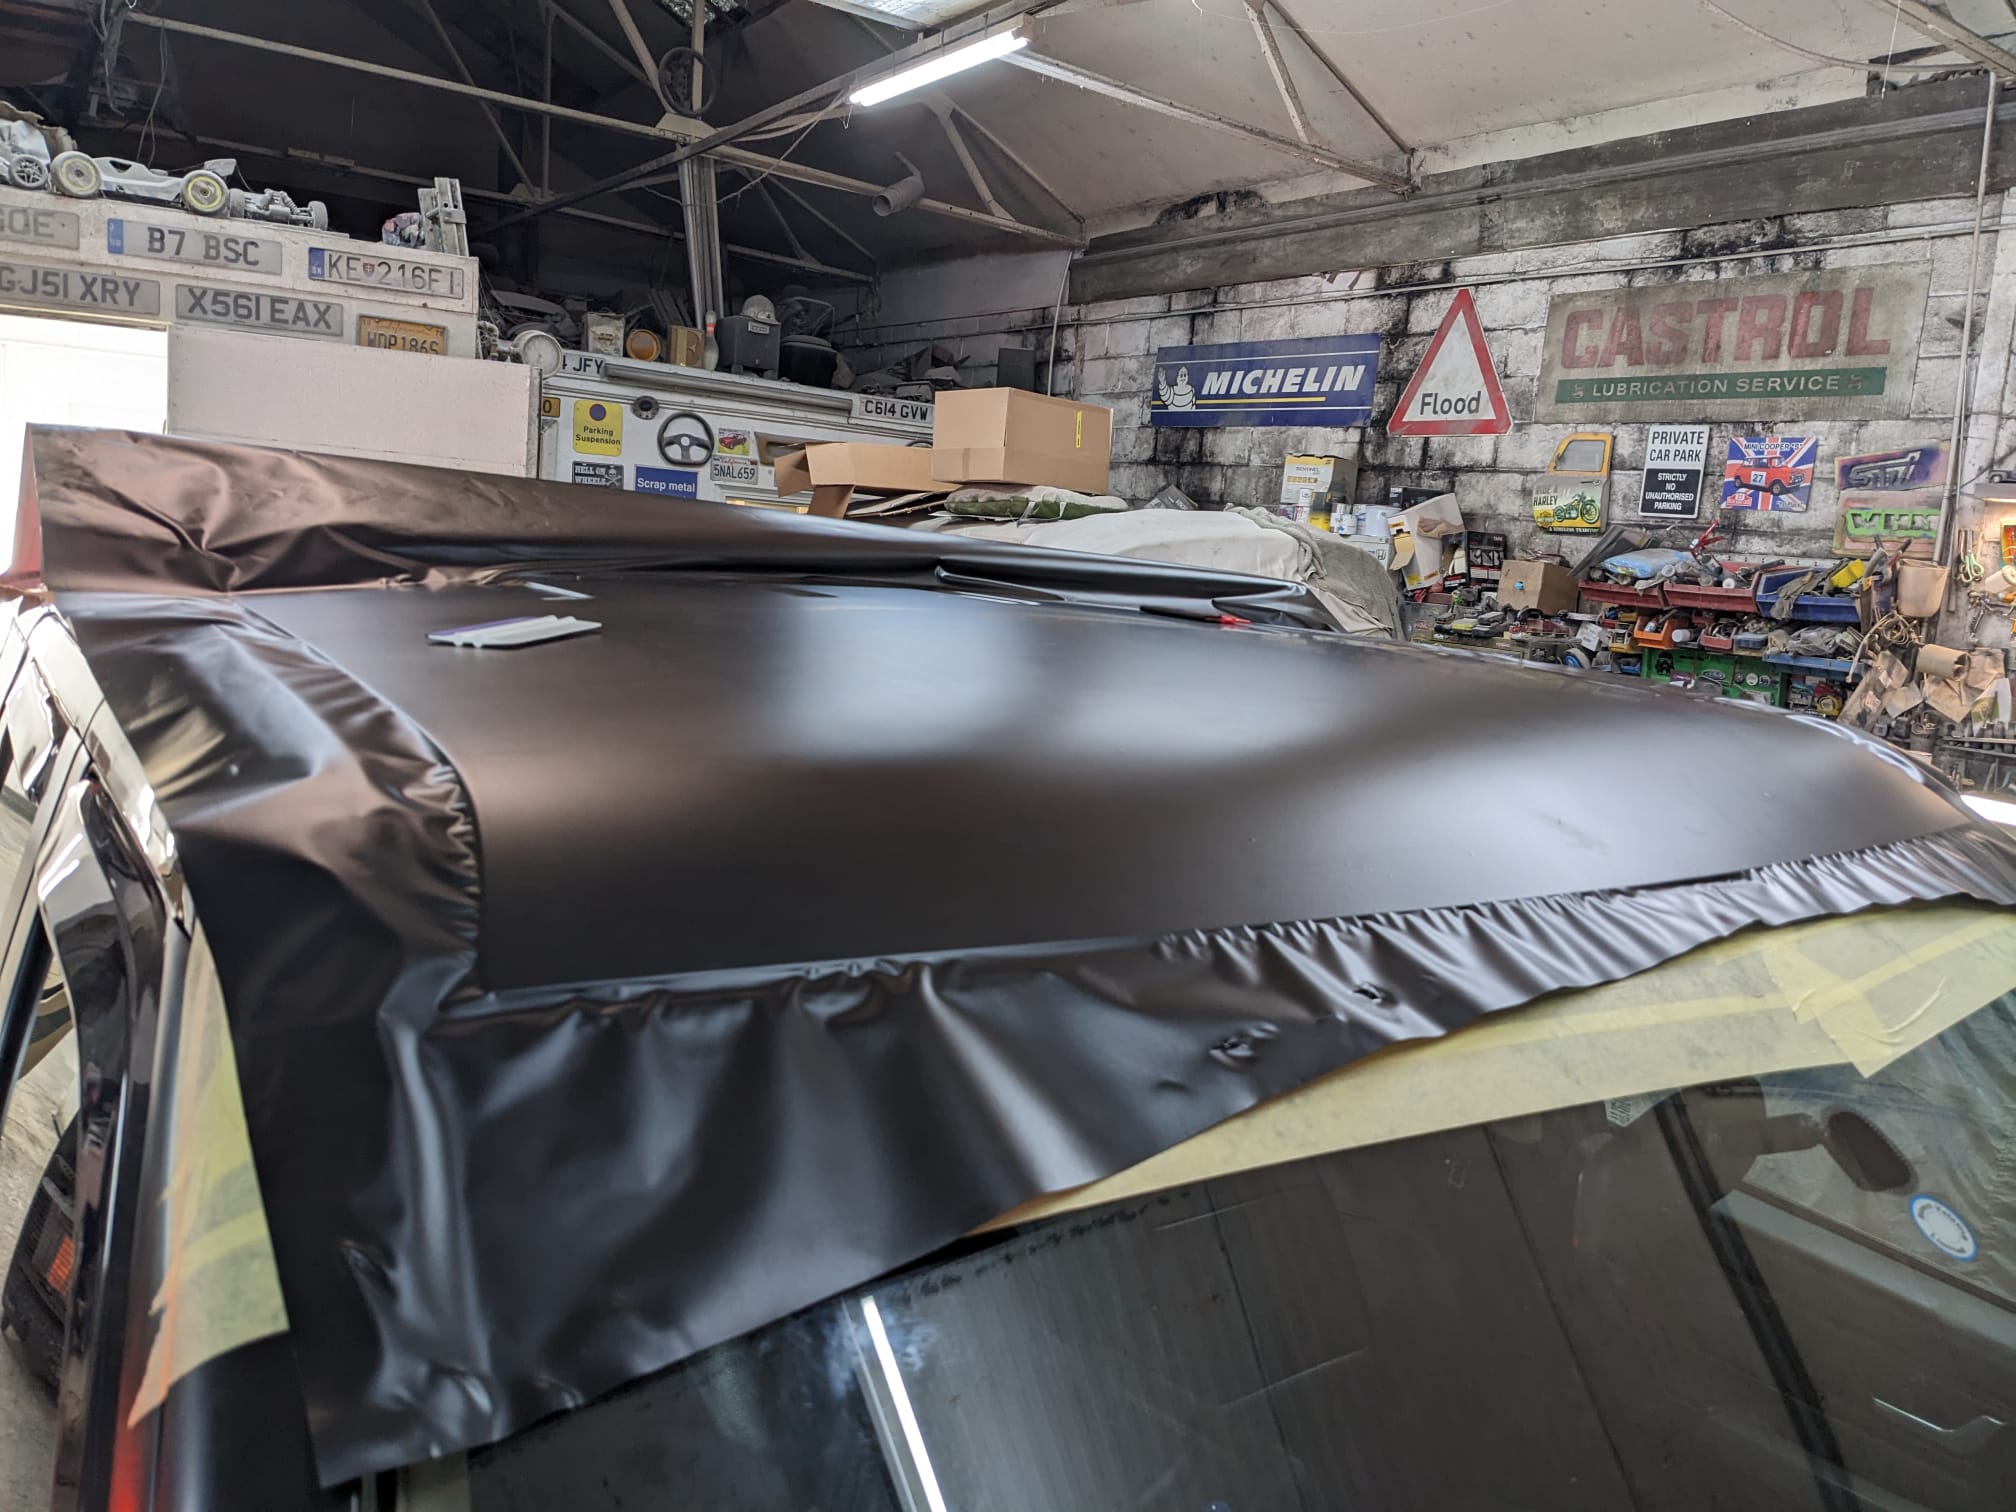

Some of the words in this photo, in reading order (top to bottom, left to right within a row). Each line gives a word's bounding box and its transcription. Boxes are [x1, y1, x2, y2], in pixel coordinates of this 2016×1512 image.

[147, 226, 185, 256] B7
[203, 234, 260, 267] BSC
[328, 253, 361, 282] KE
[79, 274, 141, 307] XRY
[187, 287, 261, 321] X561
[269, 297, 332, 331] EAX
[1560, 287, 1891, 369] CASTROL
[572, 357, 604, 374] JFY
[1200, 364, 1366, 395] MICHELIN
[1592, 378, 1728, 397] LUBRICATION
[1735, 375, 1841, 392] SERVICE
[864, 399, 897, 417] C614
[900, 404, 928, 421] GVW
[1420, 390, 1482, 416] Flood
[583, 425, 614, 436] Parking
[1651, 431, 1704, 445] PRIVATE
[575, 434, 621, 446] Suspension
[1759, 442, 1790, 451] COOPER
[1649, 449, 1671, 462] CAR
[1672, 449, 1702, 463] PARK
[713, 463, 756, 480] 5NAL659
[1657, 472, 1687, 481] STRICTLY
[1752, 473, 1764, 483] 27
[637, 477, 666, 492] Scrap
[668, 481, 695, 493] metal
[1665, 482, 1676, 491] NO
[1533, 495, 1558, 506] HARLEY
[1645, 491, 1694, 501] UNAUTHORISED
[1654, 501, 1682, 511] PARKING
